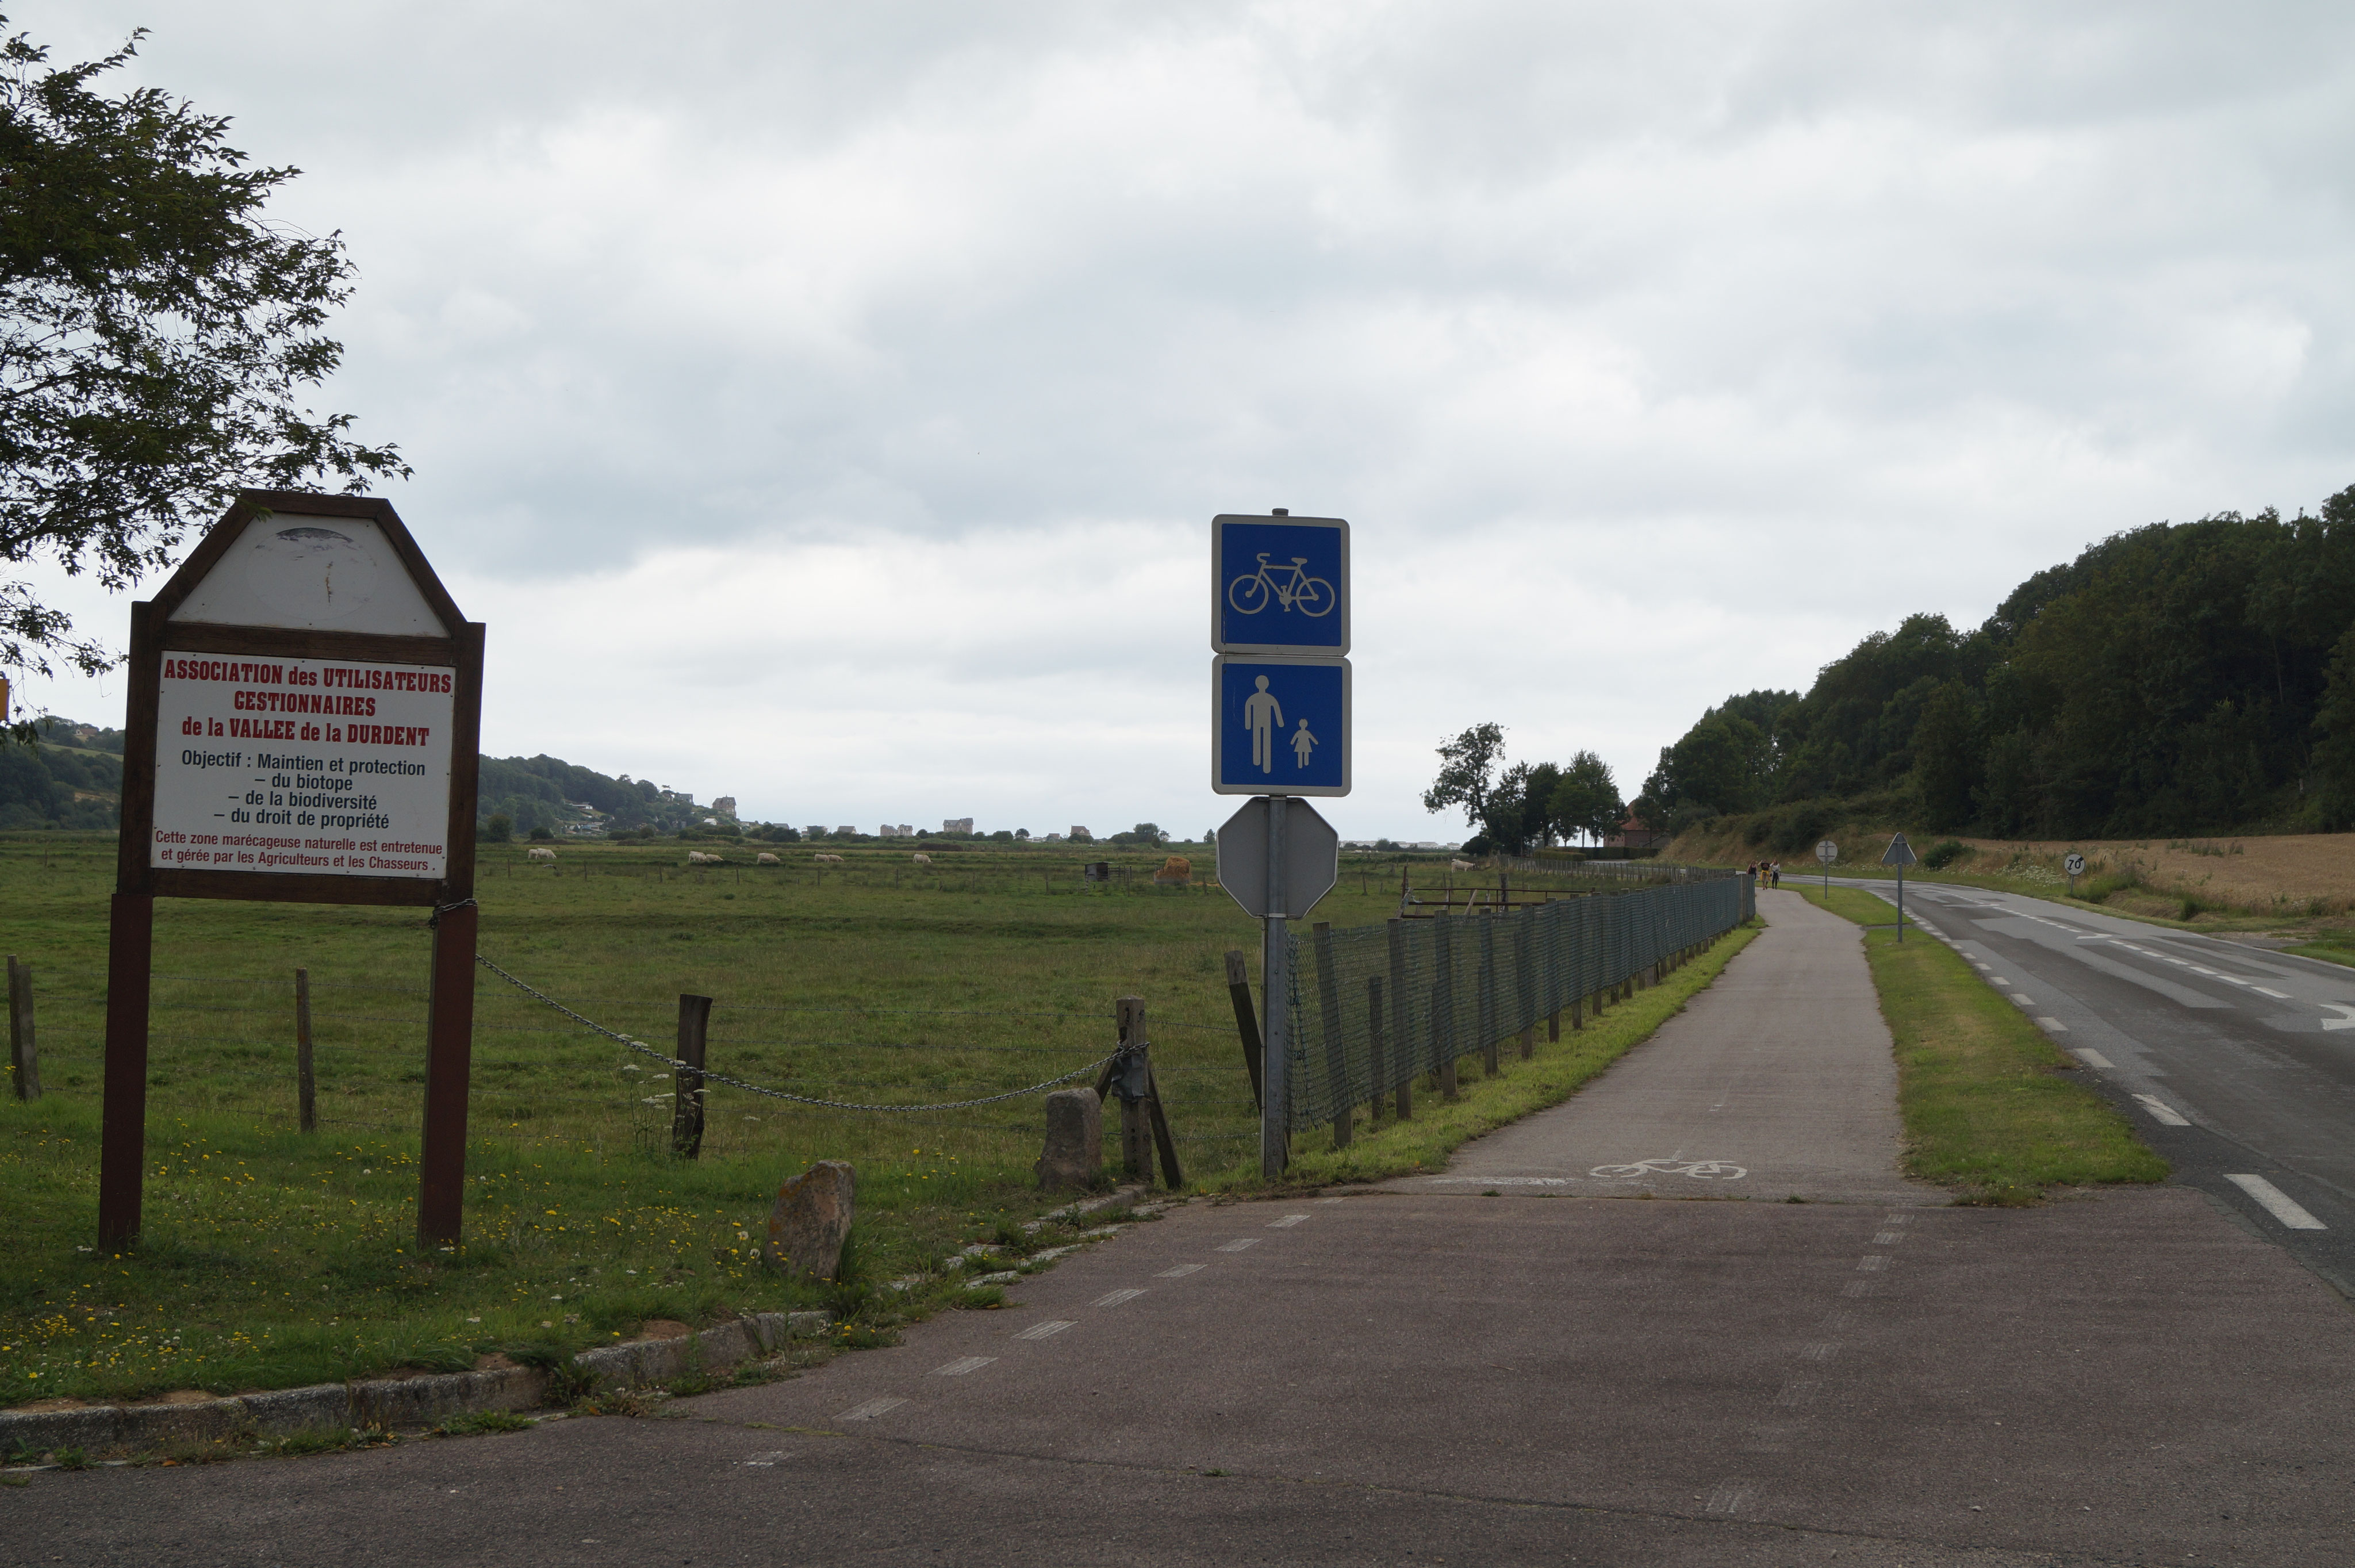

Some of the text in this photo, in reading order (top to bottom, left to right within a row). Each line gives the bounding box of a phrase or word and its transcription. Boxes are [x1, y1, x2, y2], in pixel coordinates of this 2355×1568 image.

[163, 659, 451, 693] ASSOCIATION des UTILISATEURS
[234, 690, 376, 717] GESTIONNAIRES
[182, 716, 429, 746] de la VALLEE de la DURDENT
[182, 749, 242, 769] Objectif
[258, 753, 323, 771] Maintien
[329, 757, 344, 772] et
[349, 759, 425, 776] protection
[271, 772, 290, 788] du
[296, 773, 353, 793] biotope
[246, 789, 264, 806] de
[270, 791, 283, 806] la
[289, 791, 377, 810] biodiversité
[231, 807, 250, 823] du
[256, 808, 292, 825] droit
[297, 810, 316, 826] de
[320, 812, 389, 831] propriété
[155, 830, 442, 854] Cette zone marécageuse naturelle est entretenue
[161, 848, 173, 860] et
[177, 848, 210, 864] gérée
[214, 852, 234, 865] par
[237, 850, 254, 864] les
[258, 852, 329, 867] Agriculteurs
[333, 855, 345, 867] et
[348, 855, 365, 868] les
[369, 856, 428, 871] Chasseurs
[2068, 859, 2081, 870] 70
